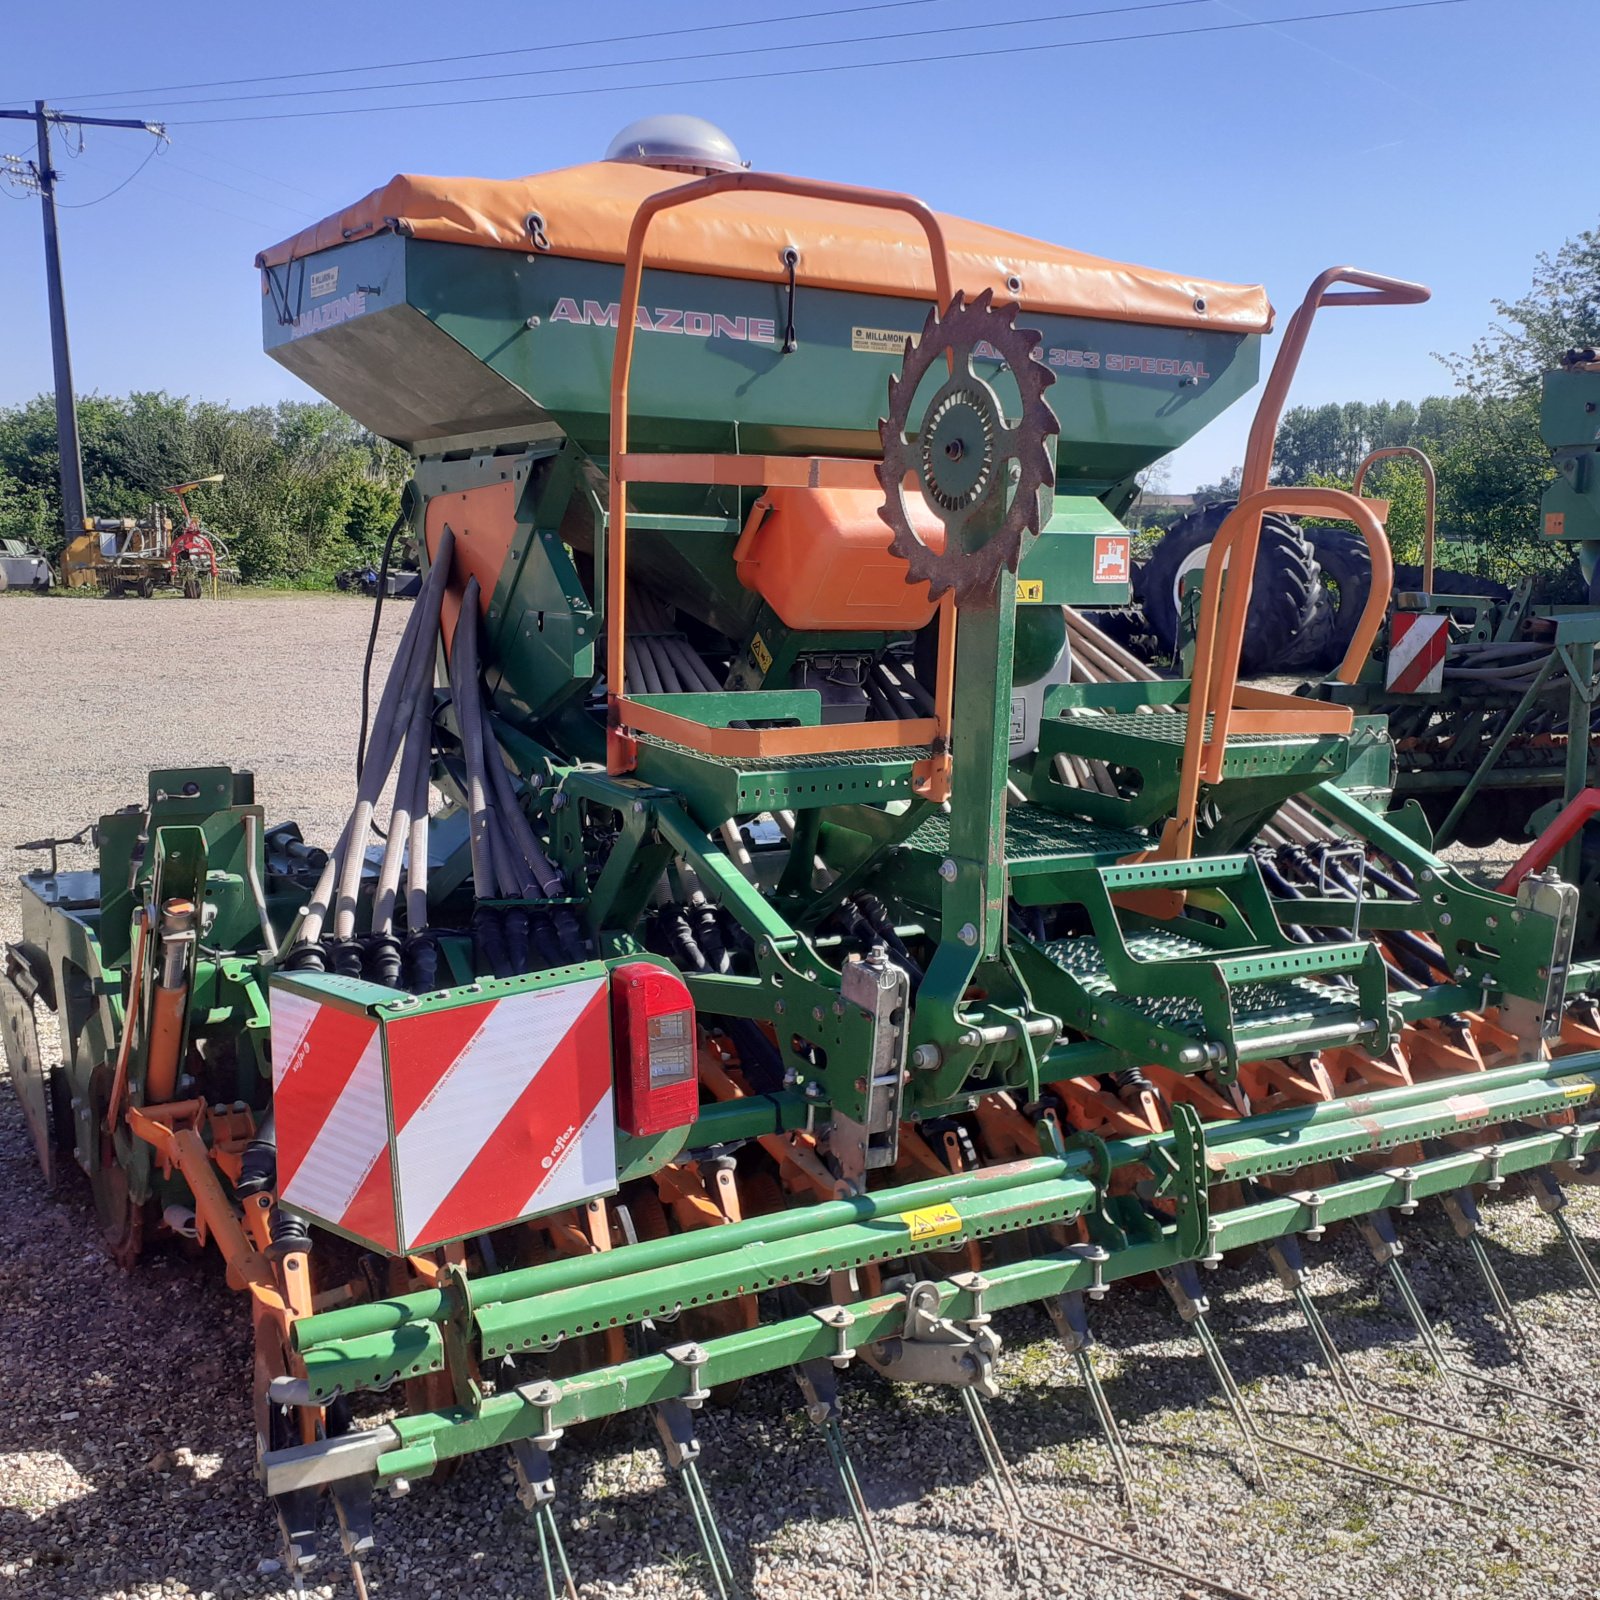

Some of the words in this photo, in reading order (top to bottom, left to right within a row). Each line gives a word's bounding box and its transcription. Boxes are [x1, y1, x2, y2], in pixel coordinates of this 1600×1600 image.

[550, 297, 775, 344] AMAZONE
[865, 331, 904, 343] MILLAMON
[1048, 348, 1100, 369] 353
[1105, 353, 1210, 379] SPECIAL
[551, 1125, 576, 1157] reflex
